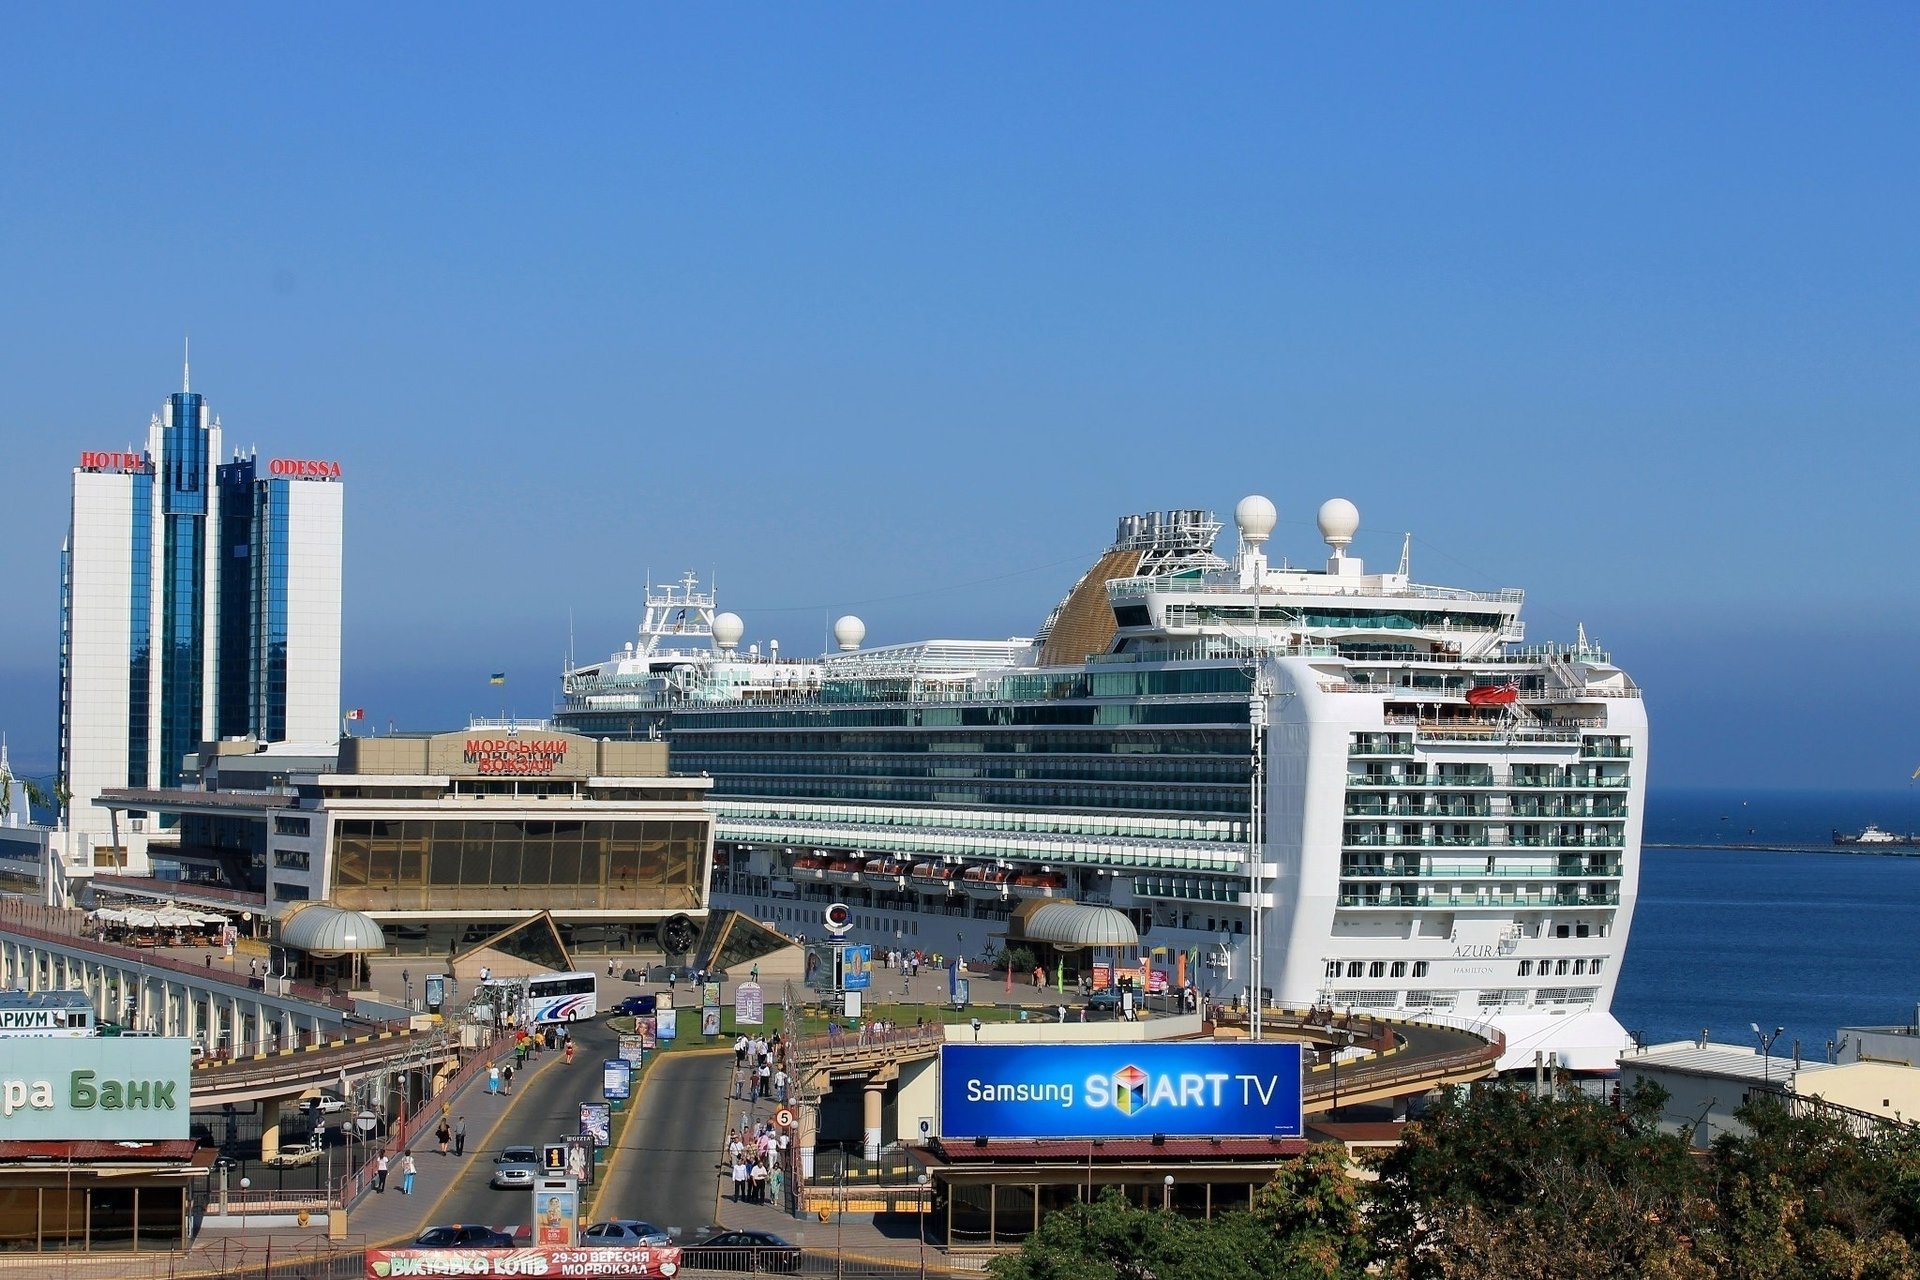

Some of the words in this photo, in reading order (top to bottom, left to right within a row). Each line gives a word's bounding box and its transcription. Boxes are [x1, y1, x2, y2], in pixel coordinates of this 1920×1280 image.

[82, 452, 145, 468] HOTEL
[269, 459, 341, 476] ODESSA
[466, 739, 567, 753] МОРСЬКИЙ
[479, 758, 554, 772] ВОКЗАЛ
[1452, 944, 1502, 957] AZURA
[0, 1012, 47, 1027] РИУМ
[70, 1070, 176, 1110] Банк
[967, 1079, 1073, 1108] Samsung
[1085, 1068, 1229, 1114] SMART
[1235, 1075, 1278, 1106] TV
[781, 1112, 789, 1124] 5
[551, 1252, 587, 1263] 29-30
[590, 1251, 650, 1263] ВЕРЕСНЯ
[391, 1257, 489, 1276] ВИСТАВКА
[562, 1263, 648, 1276] МОРВОКЗАЛ
